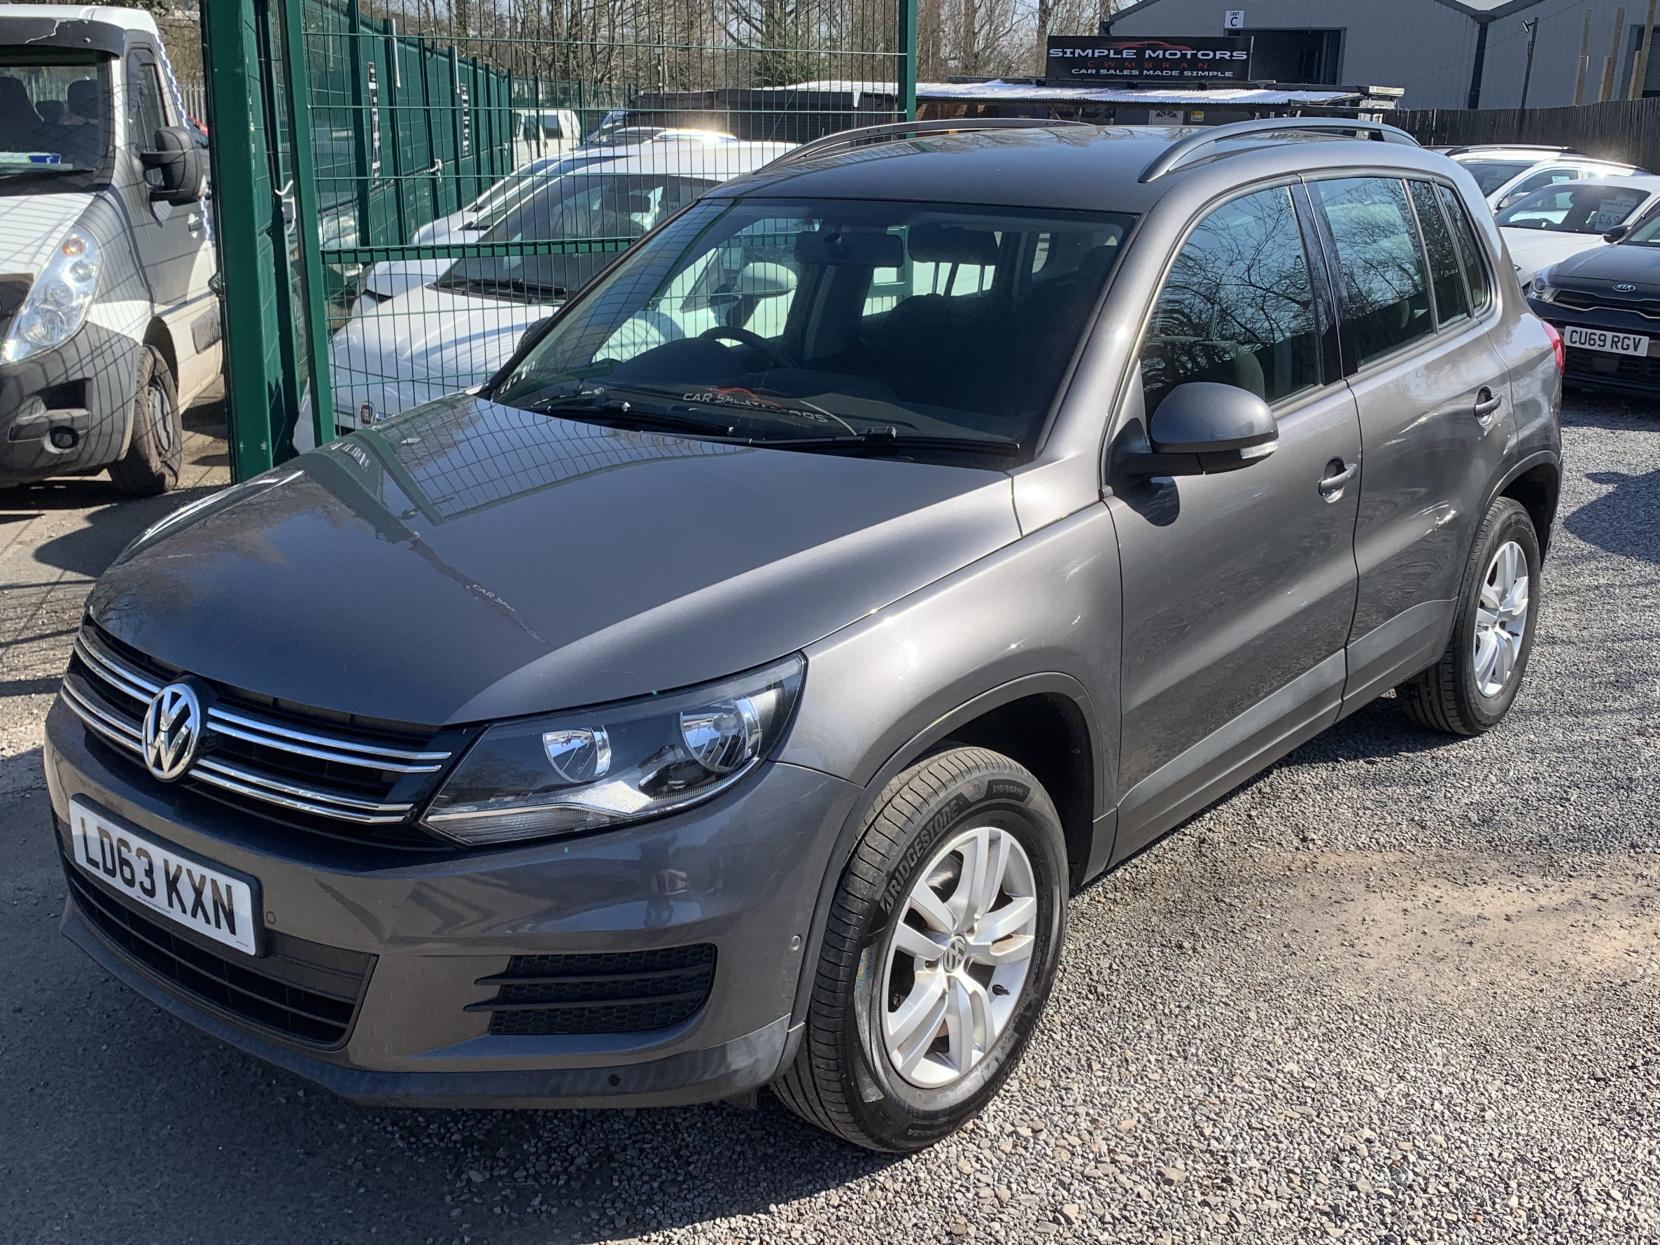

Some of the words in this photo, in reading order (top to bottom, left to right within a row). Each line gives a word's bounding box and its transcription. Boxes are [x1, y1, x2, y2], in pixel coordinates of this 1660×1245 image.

[1230, 16, 1238, 27] C
[1049, 48, 1137, 59] SIMPLE
[1144, 49, 1248, 60] MOTORS
[1087, 60, 1208, 69] CWMBRAN
[1183, 70, 1234, 78] SIMPLE
[1569, 329, 1607, 348] CU69
[1610, 334, 1642, 352] RGV
[682, 392, 712, 403] CAR
[880, 800, 962, 915] BRIDGESTONE
[80, 816, 157, 899] LD63
[163, 858, 237, 936] KXN
